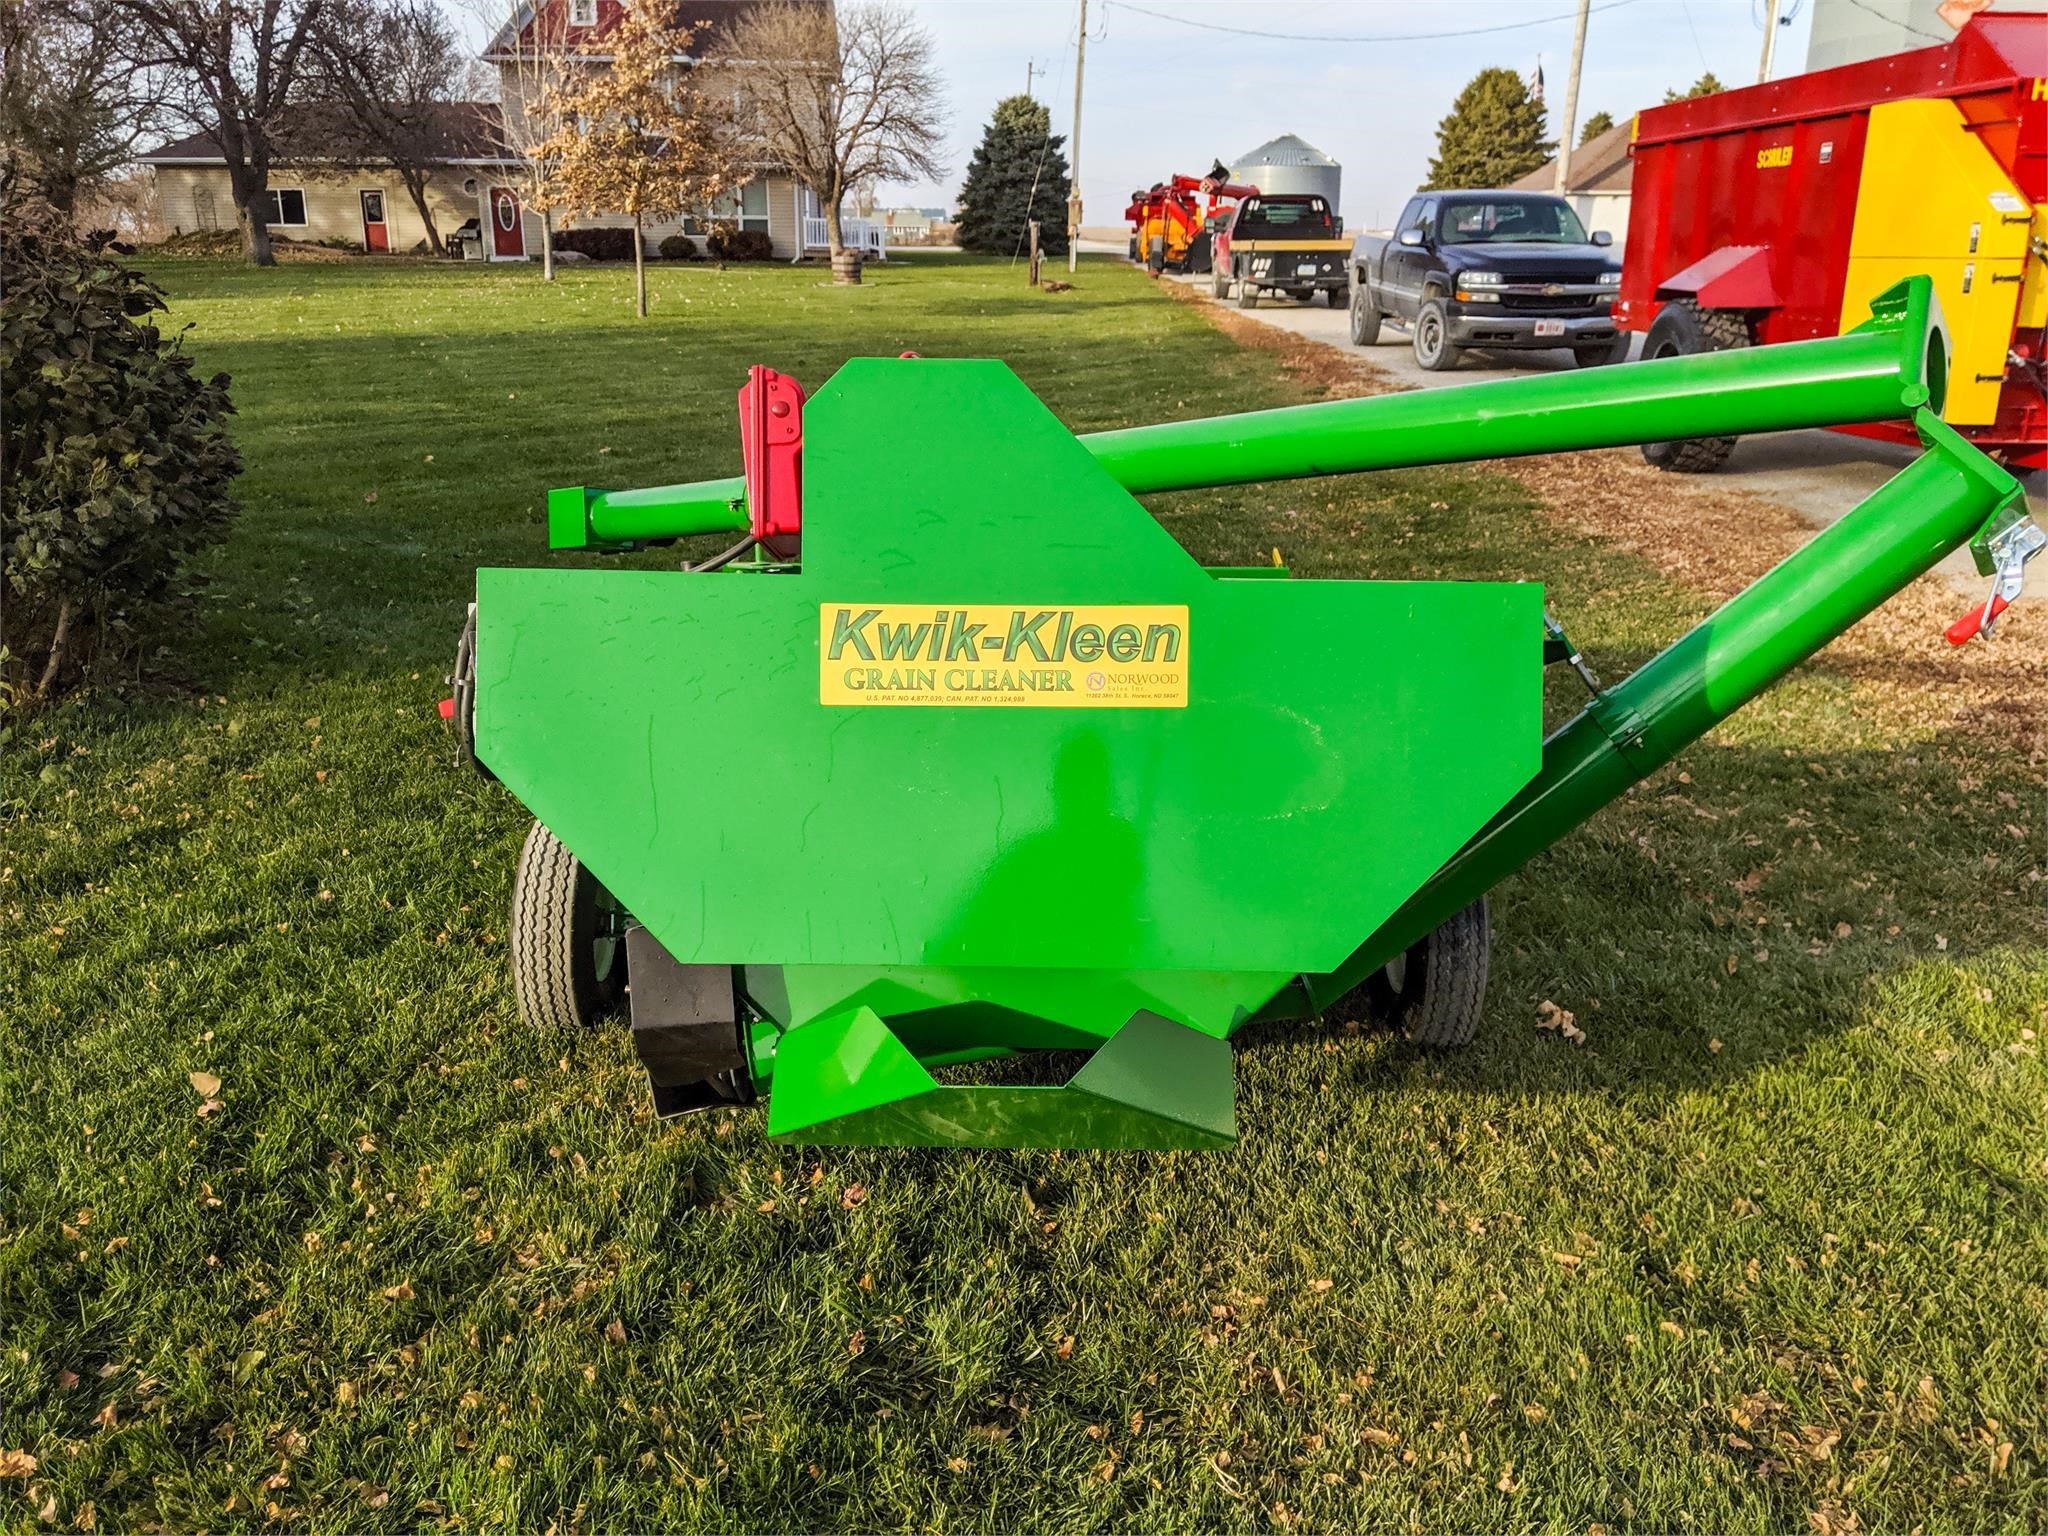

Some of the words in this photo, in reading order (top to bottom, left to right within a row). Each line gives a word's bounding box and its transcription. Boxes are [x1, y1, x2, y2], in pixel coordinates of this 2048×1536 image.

[828, 609, 1181, 663] Kwik-Kleen
[844, 667, 936, 690] GRAIN
[944, 669, 1074, 692] CLEANER
[1108, 673, 1179, 685] NORWOOD
